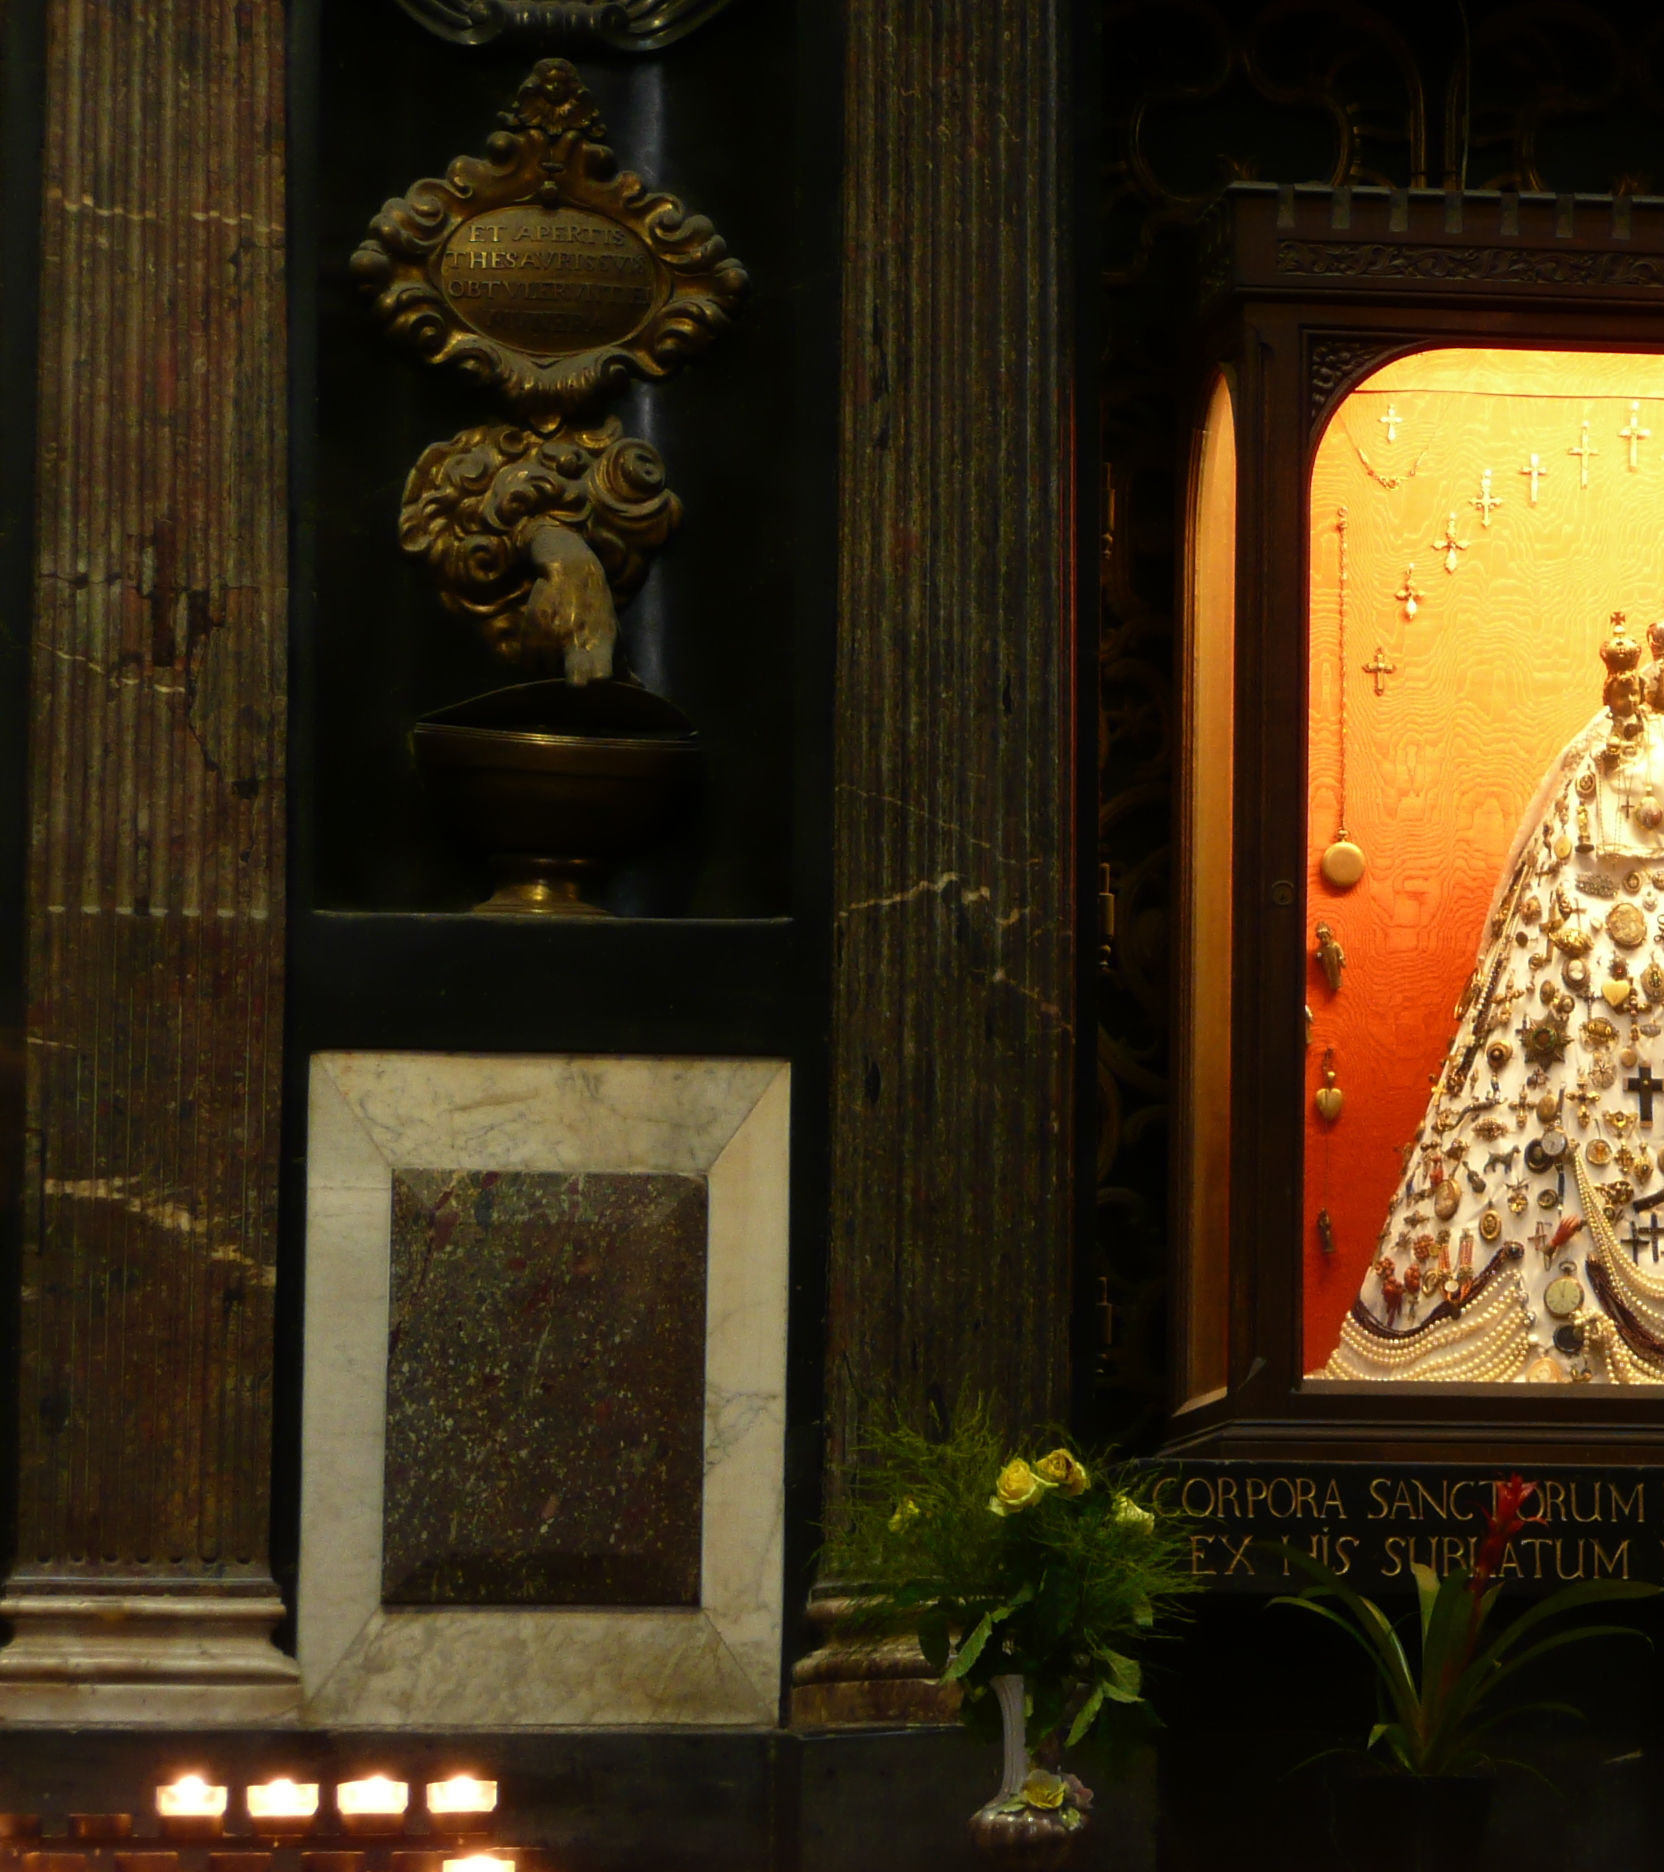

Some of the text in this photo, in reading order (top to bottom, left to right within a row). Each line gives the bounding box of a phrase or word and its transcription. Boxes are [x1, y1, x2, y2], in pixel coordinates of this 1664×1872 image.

[468, 225, 507, 244] ET
[1152, 1476, 1348, 1519] CORPORA
[1190, 1534, 1256, 1576] EX
